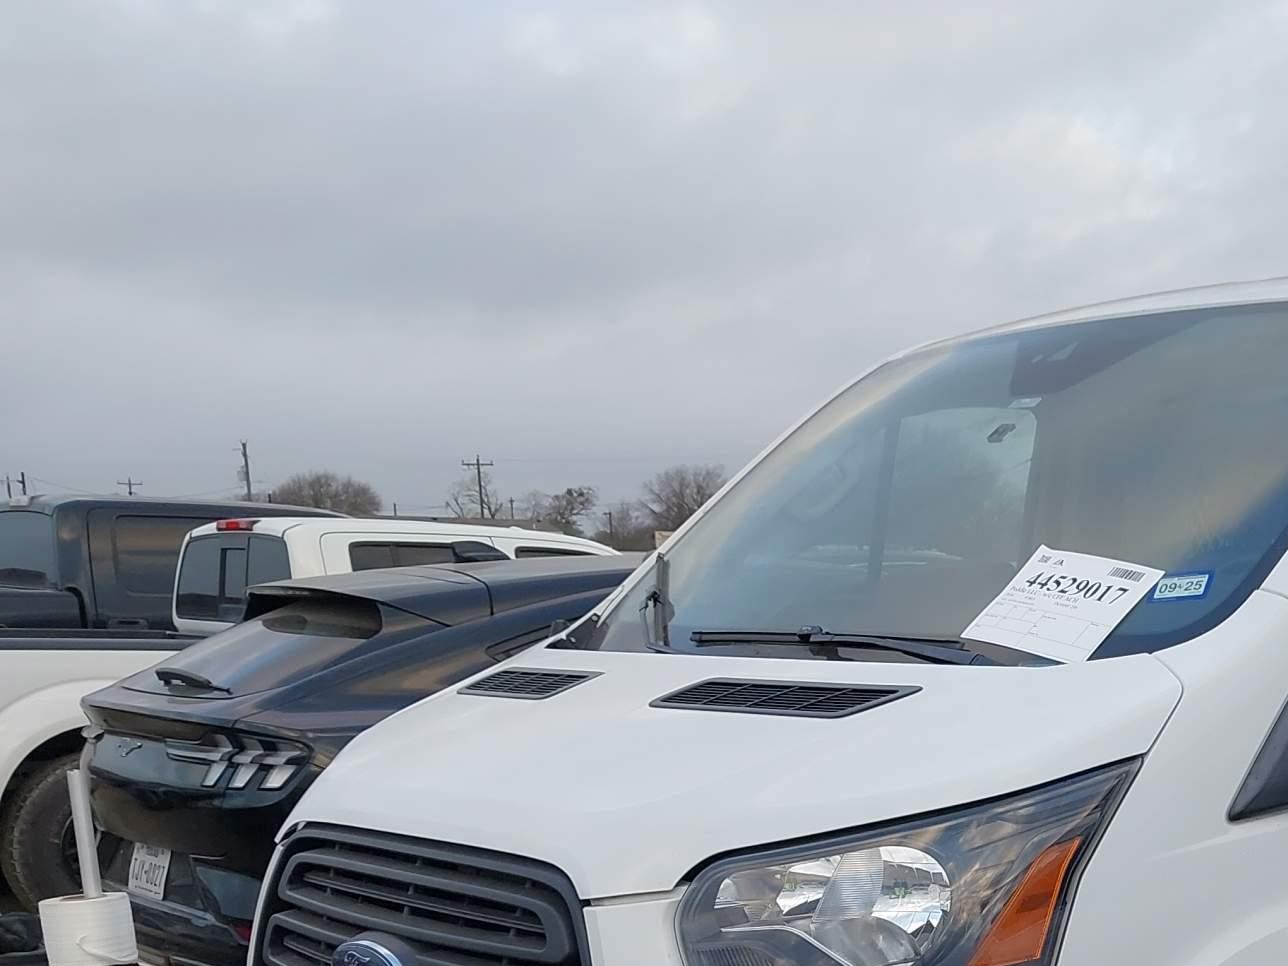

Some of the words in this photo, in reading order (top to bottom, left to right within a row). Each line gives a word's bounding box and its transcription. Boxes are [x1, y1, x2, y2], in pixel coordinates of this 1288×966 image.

[1026, 571, 1129, 605] 44529017
[1158, 582, 1177, 594] 09
[1183, 580, 1204, 592] 25
